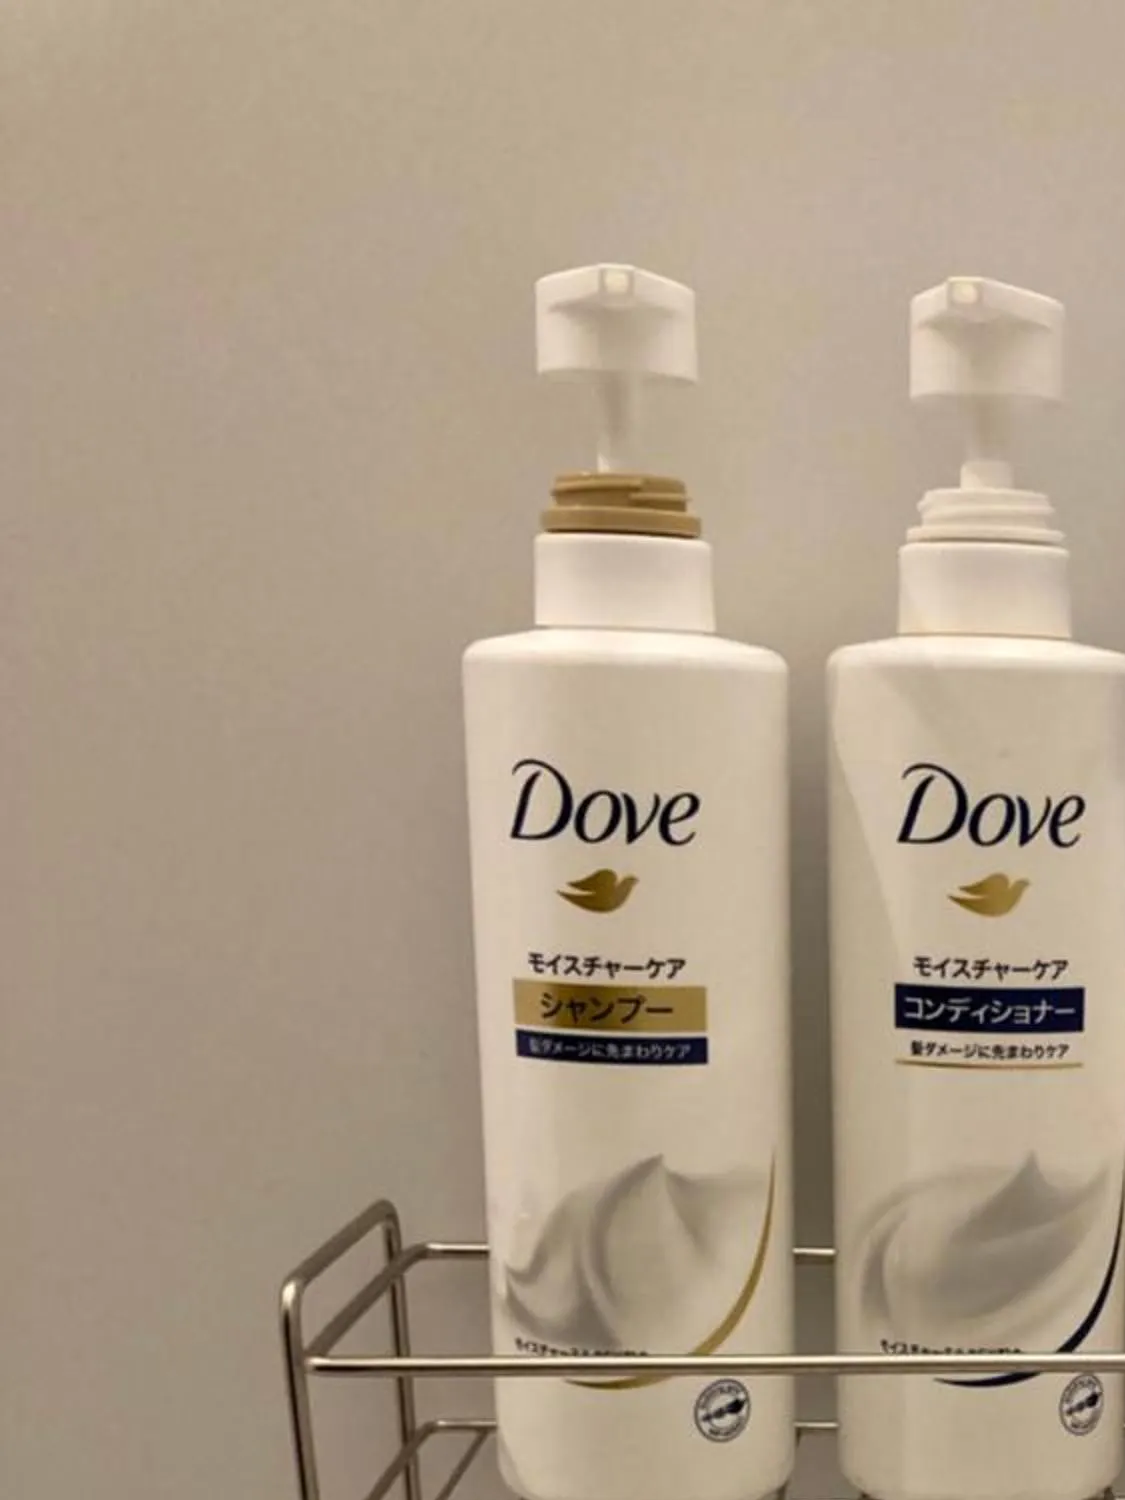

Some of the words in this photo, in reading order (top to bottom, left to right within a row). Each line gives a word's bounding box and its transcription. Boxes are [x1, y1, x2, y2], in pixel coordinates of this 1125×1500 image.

[510, 759, 701, 846] Dove
[897, 763, 1086, 848] Dove
[528, 952, 686, 979] モイスチャーケア
[912, 956, 1070, 981] モイスチャーケア
[540, 992, 674, 1024] シャンプー
[904, 996, 1077, 1025] コンディショナー
